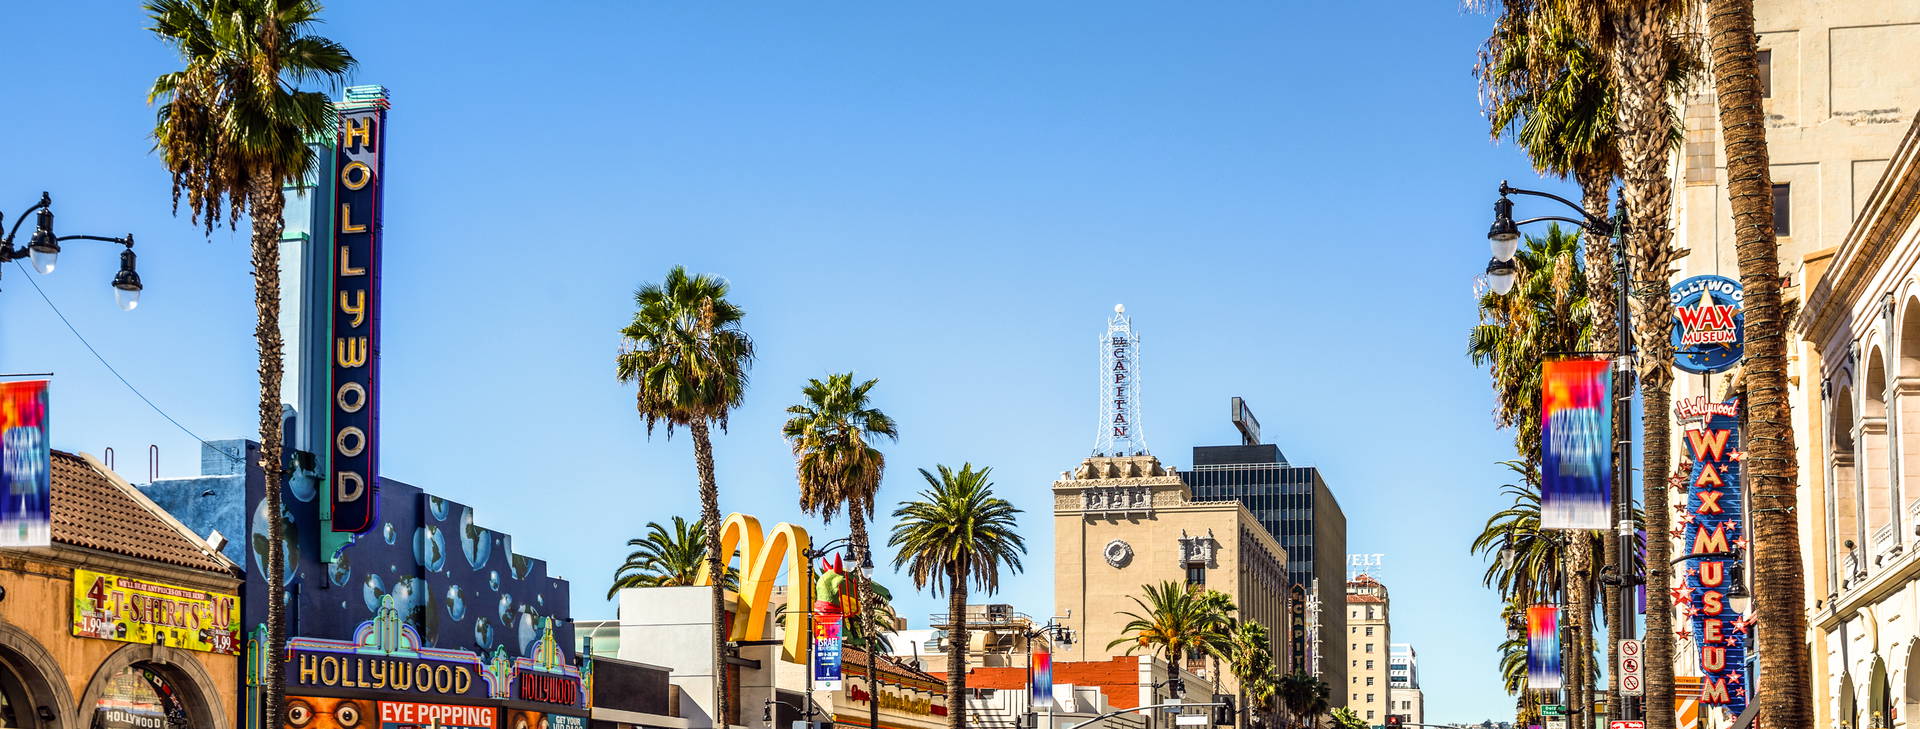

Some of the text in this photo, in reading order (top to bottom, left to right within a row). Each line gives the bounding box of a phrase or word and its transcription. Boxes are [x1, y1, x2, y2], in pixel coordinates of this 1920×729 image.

[1670, 279, 1744, 309] OLLYWOO
[337, 117, 371, 502] HOLLYWOOD
[1678, 304, 1736, 331] WAX
[1681, 330, 1737, 345] MUSEUM
[1112, 336, 1128, 437] EL CAPITAN
[1676, 396, 1739, 424] Hollywood
[1686, 429, 1731, 705] WAX MUSEUM
[87, 576, 109, 610] 4
[110, 590, 200, 631] T-SHIRTS
[818, 637, 839, 647] ISRAEL
[1293, 604, 1304, 678] CAPIT
[299, 654, 472, 695] HOLLYWOOD
[521, 673, 578, 705] HOLLYWOOD
[106, 711, 161, 728] HOLLYWOOD
[382, 702, 492, 726] EYE POPPING
[555, 715, 581, 726] GET YOUR
